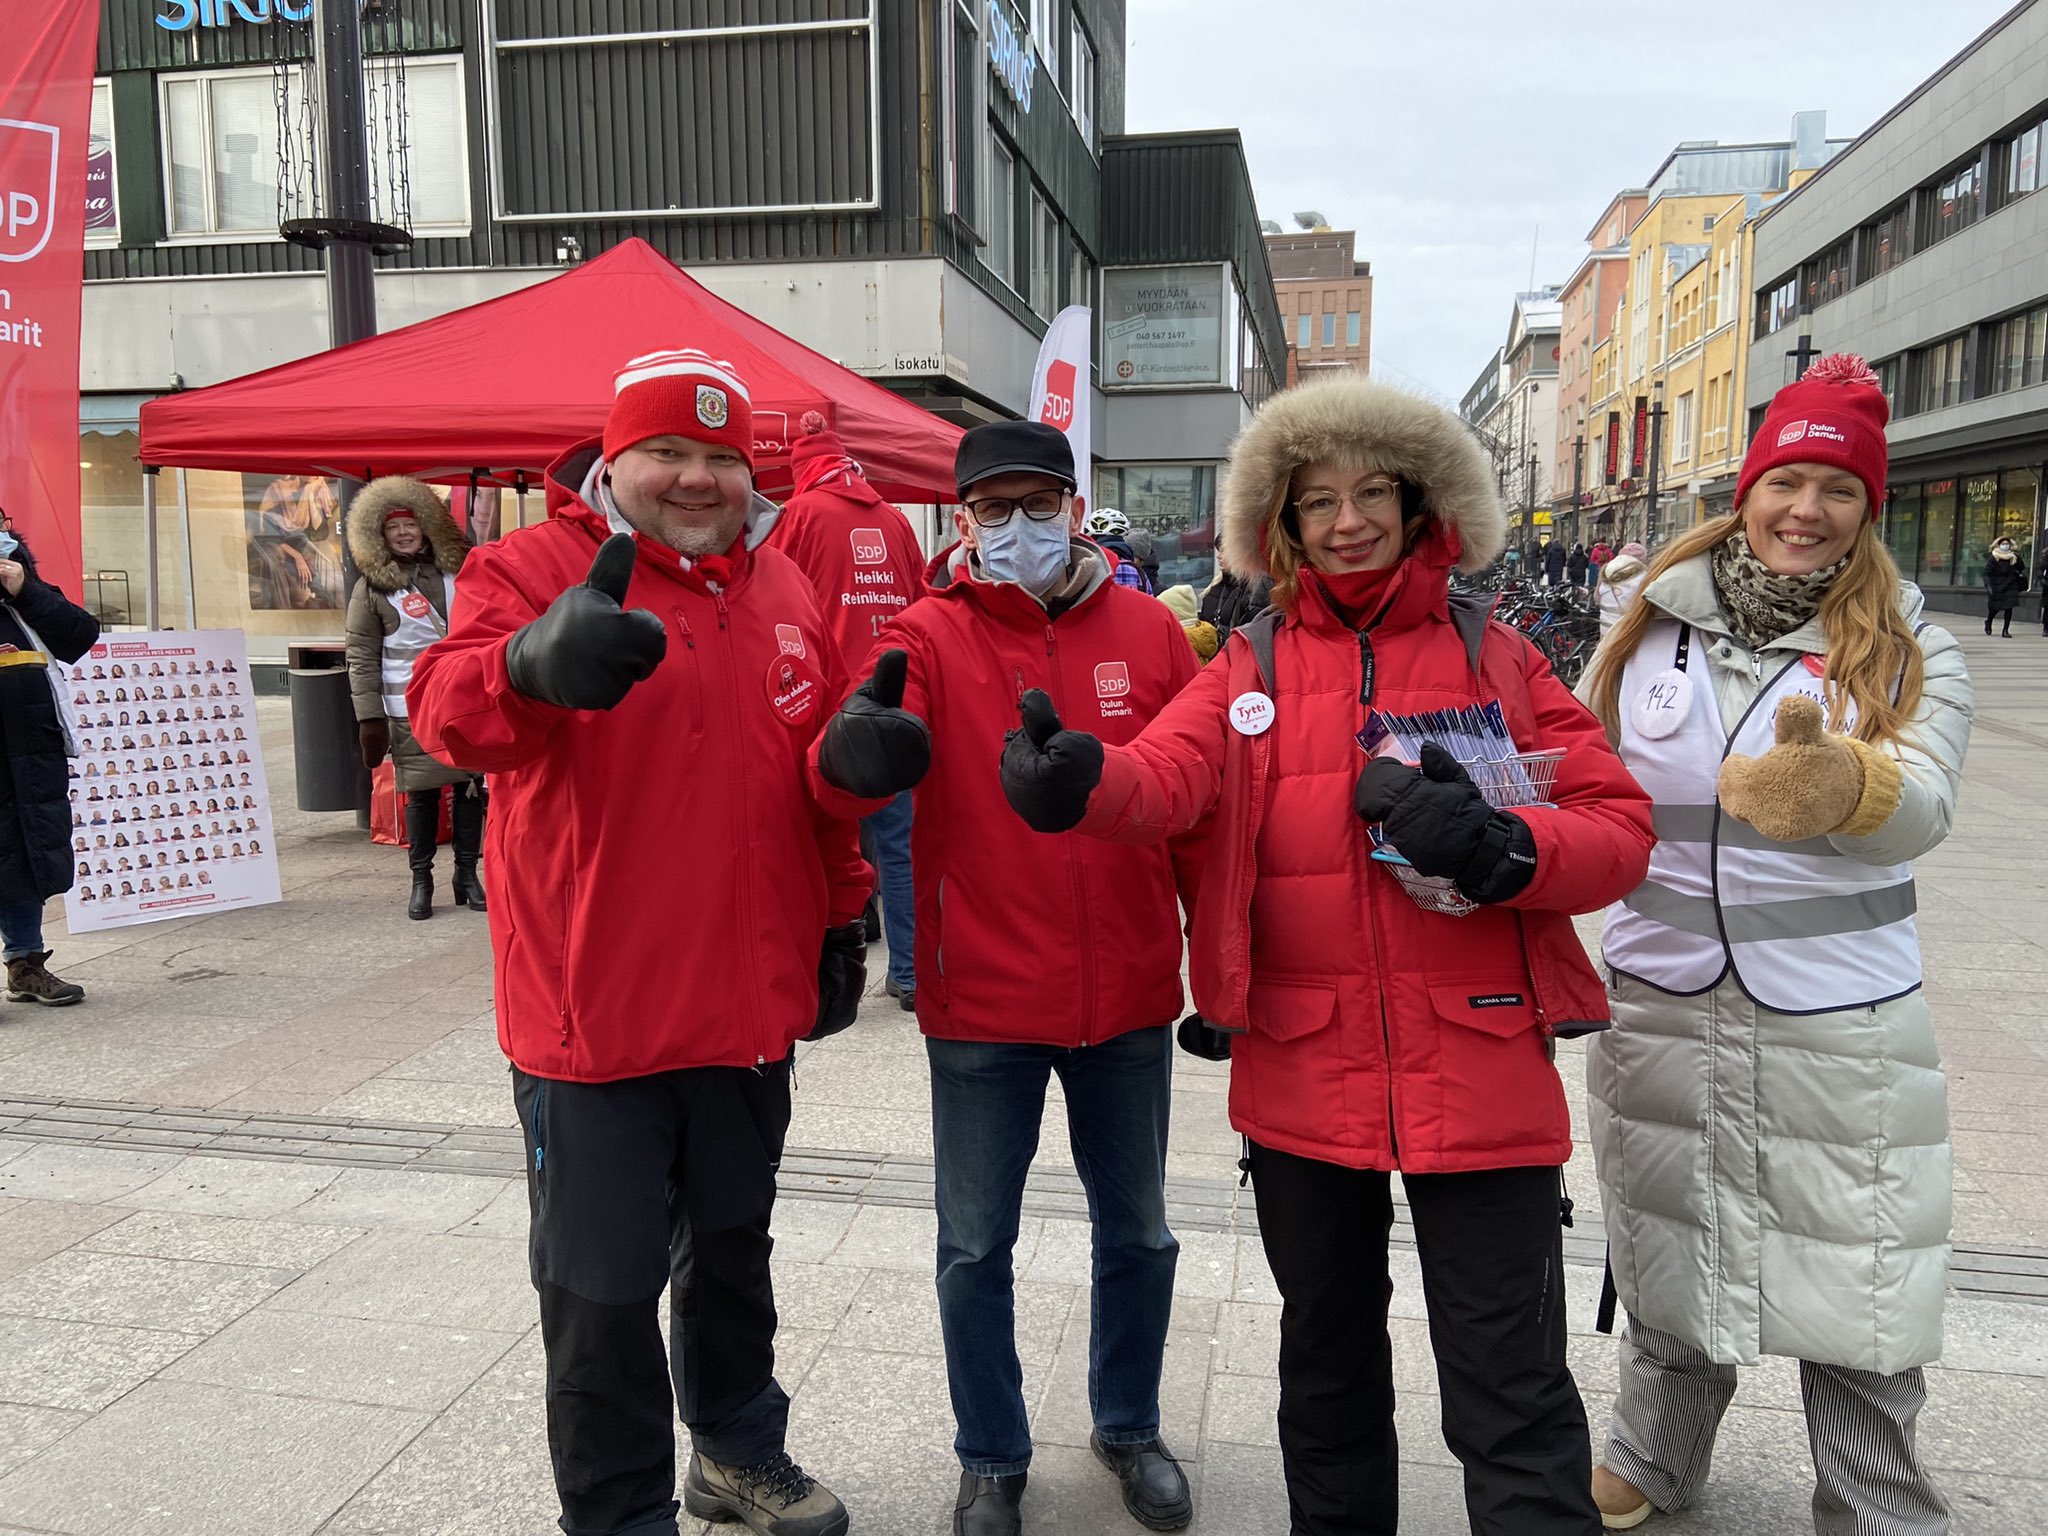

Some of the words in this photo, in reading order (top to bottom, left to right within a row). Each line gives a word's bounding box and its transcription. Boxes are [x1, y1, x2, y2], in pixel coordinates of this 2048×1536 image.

[990, 0, 1032, 114] SIRIUS
[1136, 301, 1207, 313] VUOKRATAAN
[1136, 333, 1150, 341] 040
[1152, 332, 1165, 340] 567
[1168, 331, 1186, 339] 1497
[894, 356, 940, 371] Isokatu
[1045, 392, 1072, 423] SDP
[1809, 424, 1836, 433] Oulun
[1634, 408, 1646, 467] Dressmann
[1781, 431, 1802, 443] SDP
[1807, 431, 1845, 442] Demarit
[1607, 422, 1618, 475] Dressmann
[856, 545, 883, 559] SDP
[854, 571, 894, 585] Heikki
[841, 591, 908, 607] Reinikainen
[91, 650, 107, 658] SDP
[781, 641, 802, 654] SDP
[1100, 679, 1126, 692] SDP
[1646, 684, 1678, 710] 142
[1100, 700, 1124, 709] Oulun
[1236, 701, 1266, 721] Tytti
[1101, 707, 1133, 718] Demarit
